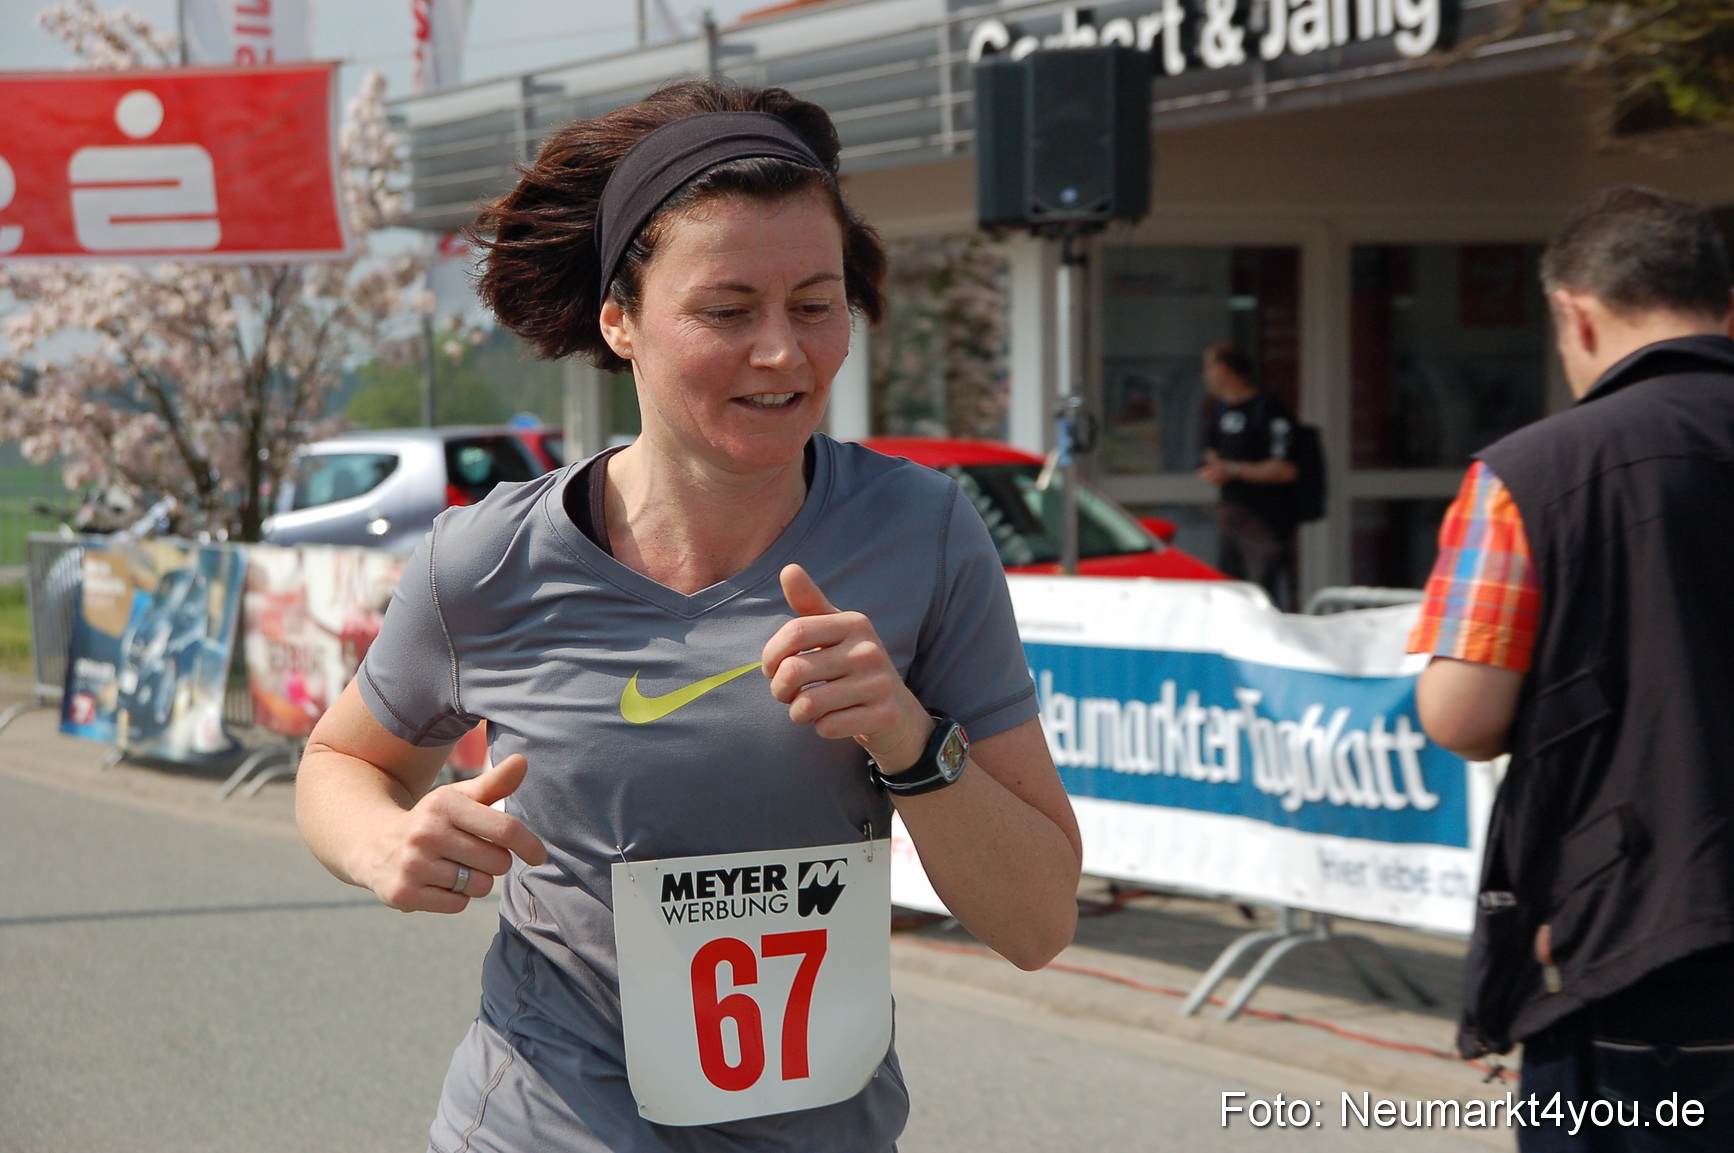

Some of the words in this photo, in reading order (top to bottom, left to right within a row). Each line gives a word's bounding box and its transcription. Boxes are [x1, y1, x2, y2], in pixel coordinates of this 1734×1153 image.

[661, 864, 788, 903] MEYER
[661, 894, 789, 925] WERBUNG
[690, 928, 828, 1092] 67
